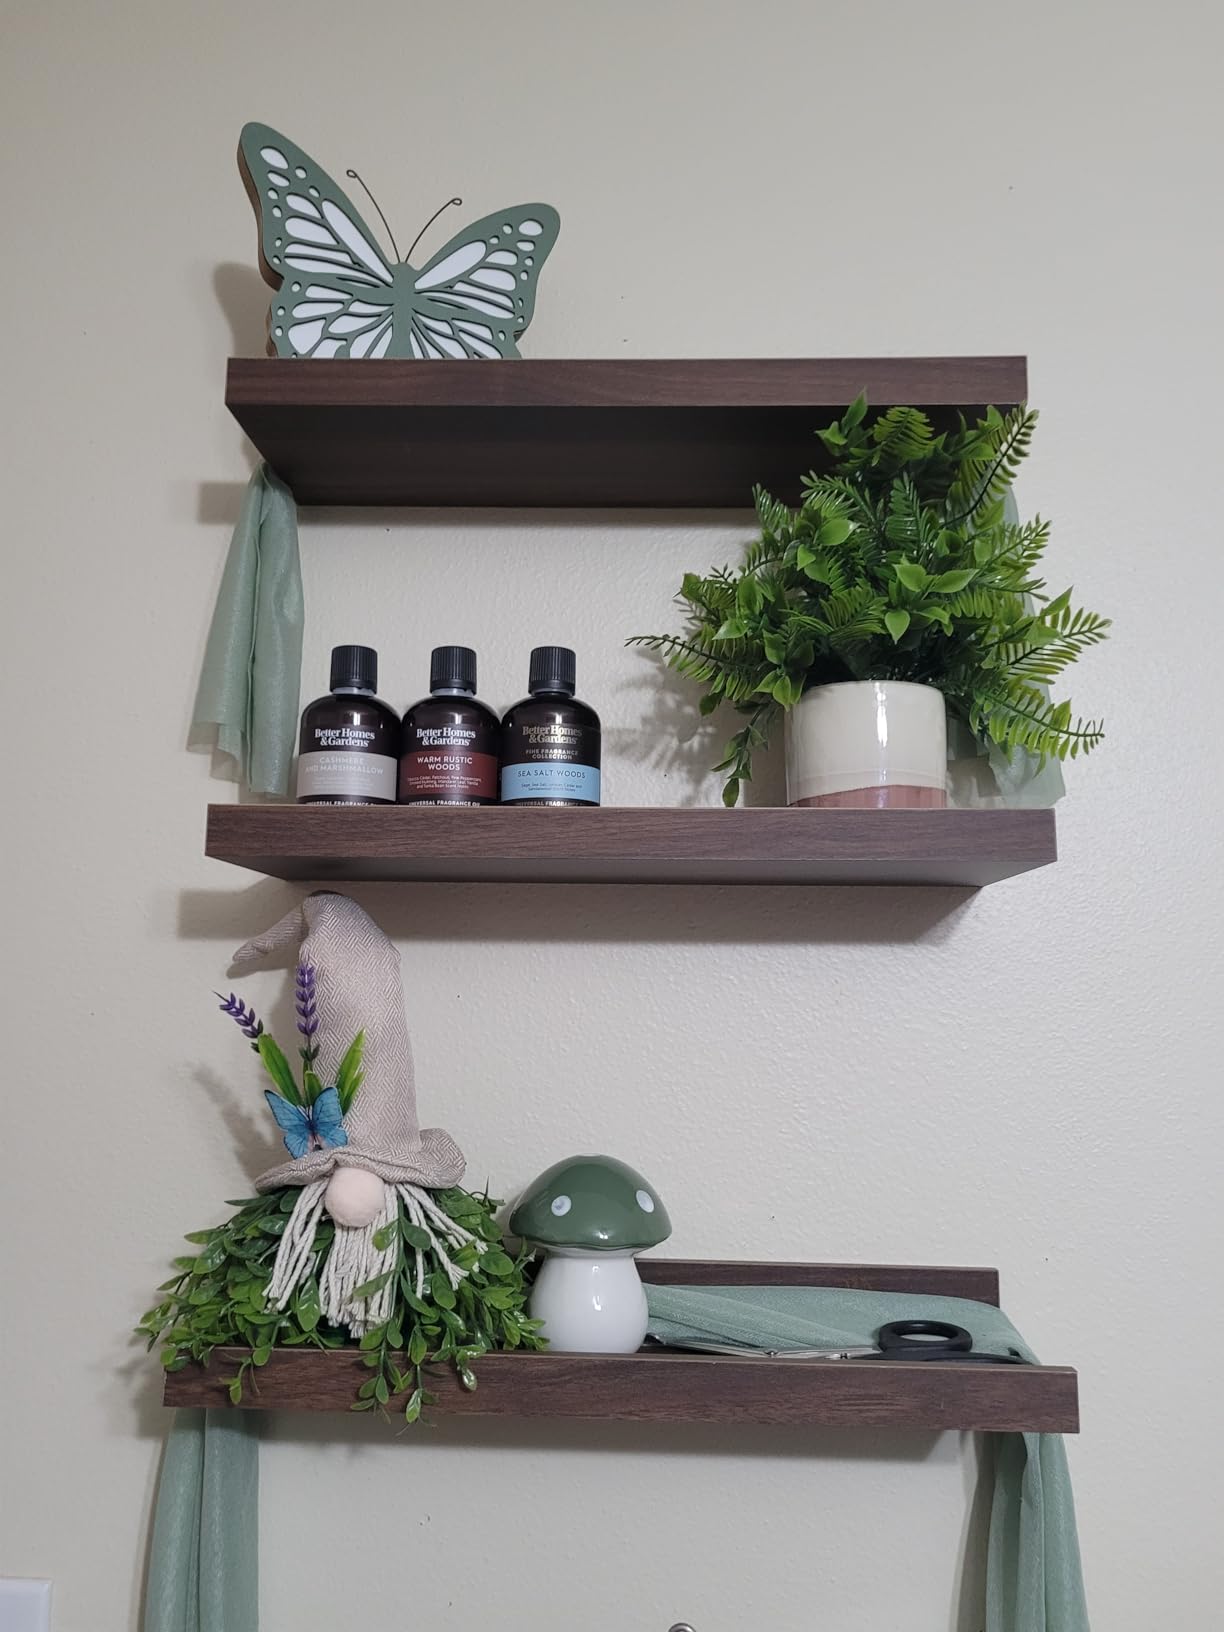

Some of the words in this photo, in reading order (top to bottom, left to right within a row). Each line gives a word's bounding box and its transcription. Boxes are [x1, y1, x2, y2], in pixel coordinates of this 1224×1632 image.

[314, 728, 341, 738] Better
[342, 728, 376, 740] Homes
[416, 728, 442, 738] Better
[442, 727, 476, 739] Homes
[522, 726, 550, 736] Better
[550, 724, 582, 736] Homes
[320, 757, 364, 765] CASHMERE
[417, 756, 441, 764] WARM
[444, 756, 473, 764] RUSTIC
[320, 764, 384, 775] MARSHMALLOW
[556, 770, 586, 779] WOODS
